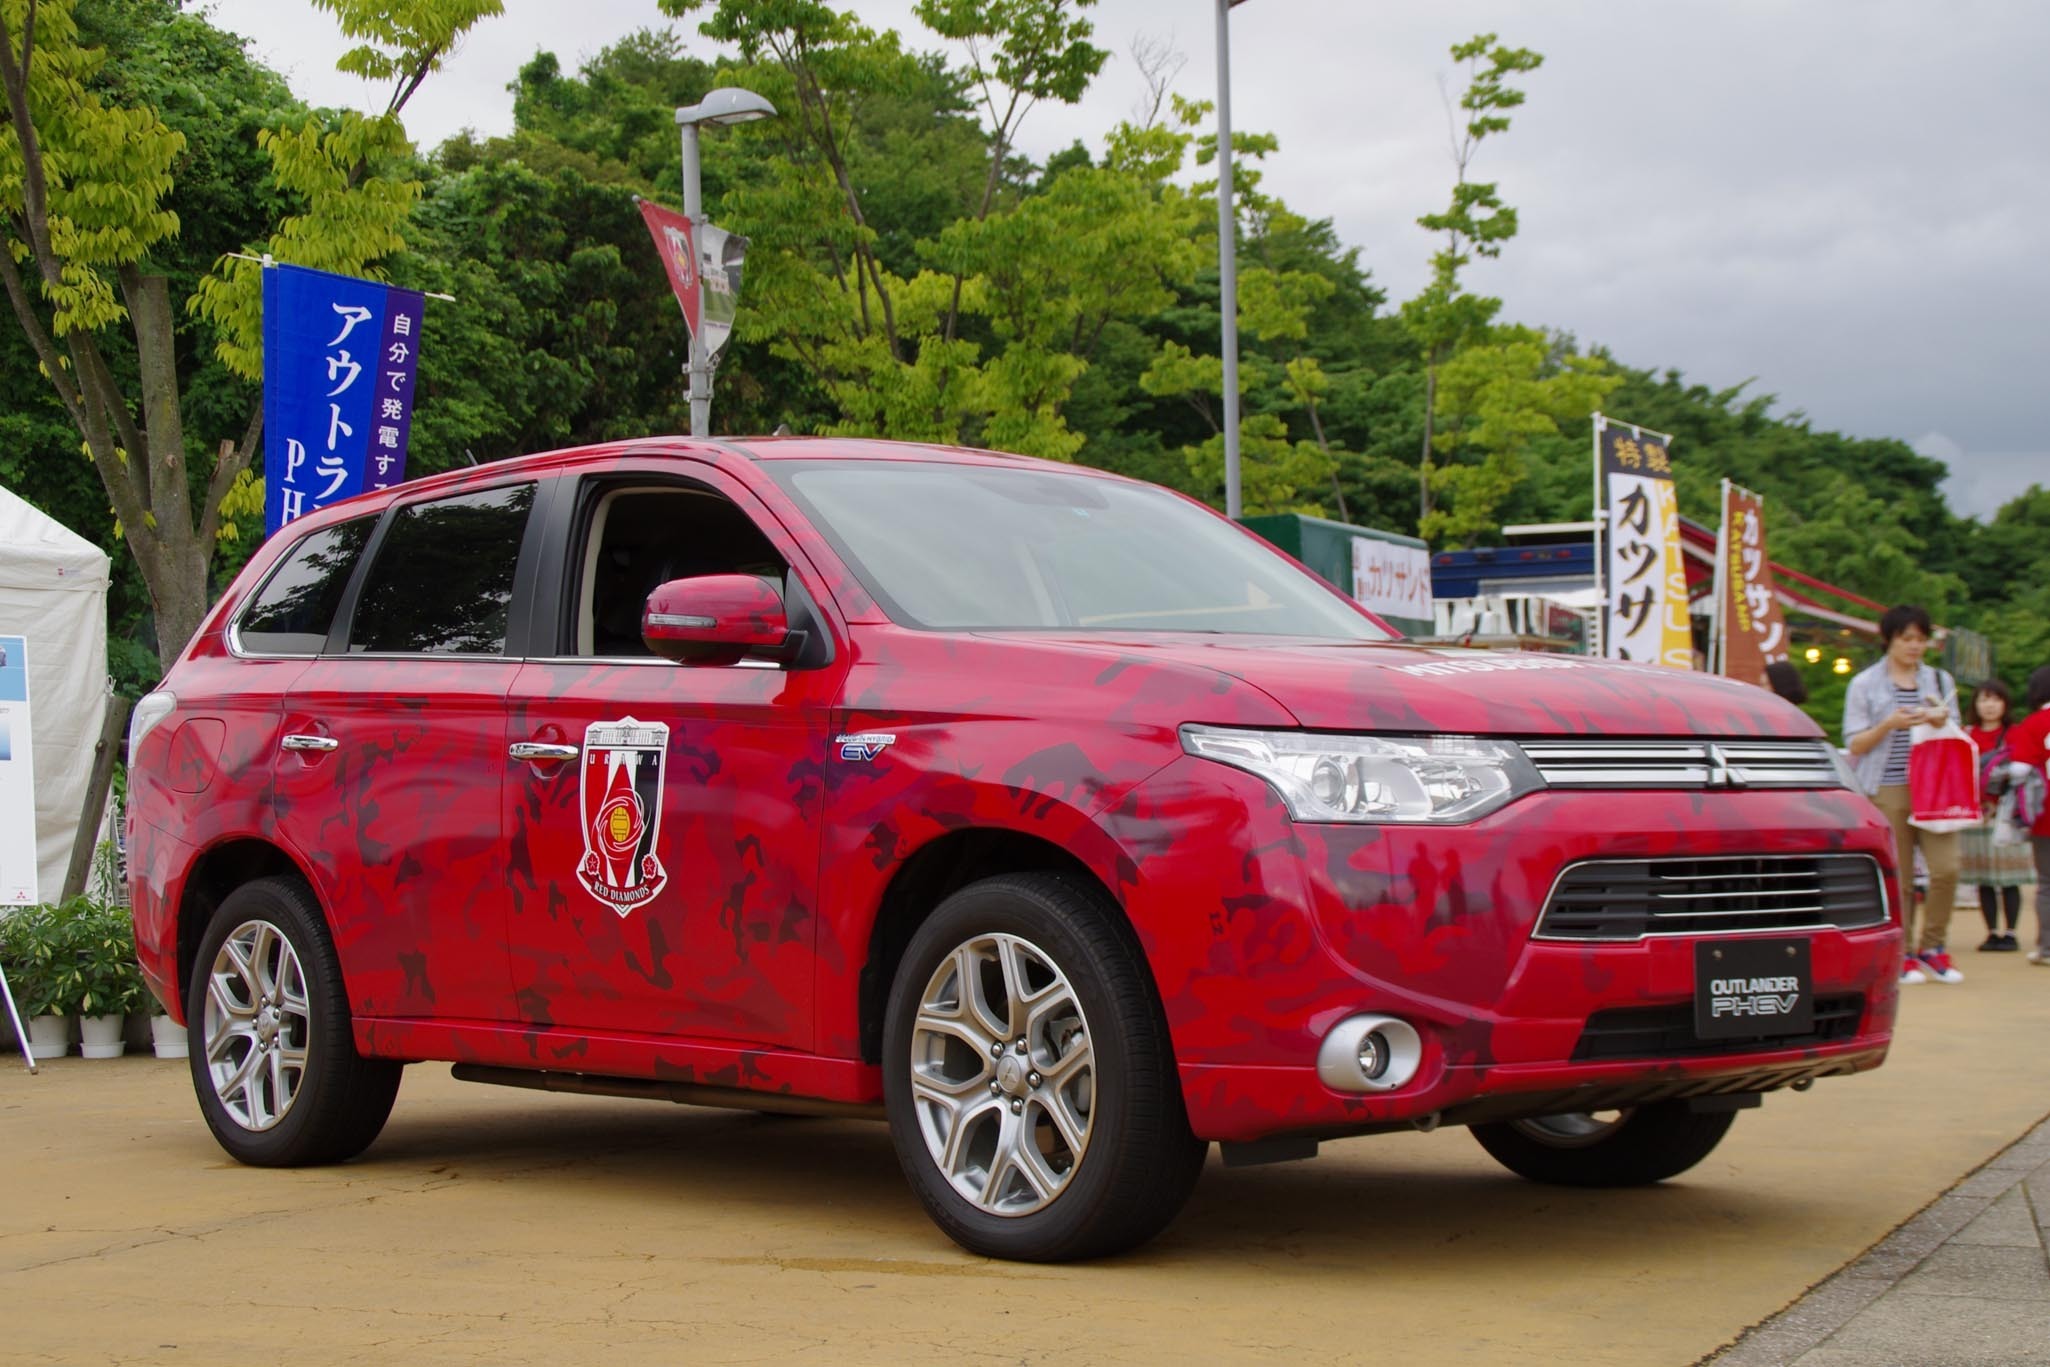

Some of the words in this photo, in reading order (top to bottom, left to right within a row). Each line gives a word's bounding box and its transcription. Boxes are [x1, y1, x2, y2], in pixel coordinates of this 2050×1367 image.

[312, 302, 373, 511] アウトラ
[374, 313, 411, 491] 自分で発電す
[1616, 483, 1658, 664] カツサ
[589, 754, 658, 766] URAWA
[841, 743, 886, 761] EV
[594, 881, 609, 898] RED
[610, 885, 650, 902] DIAMONDS
[1710, 976, 1799, 995] OUTLANDER
[1712, 993, 1800, 1017] PHEV
